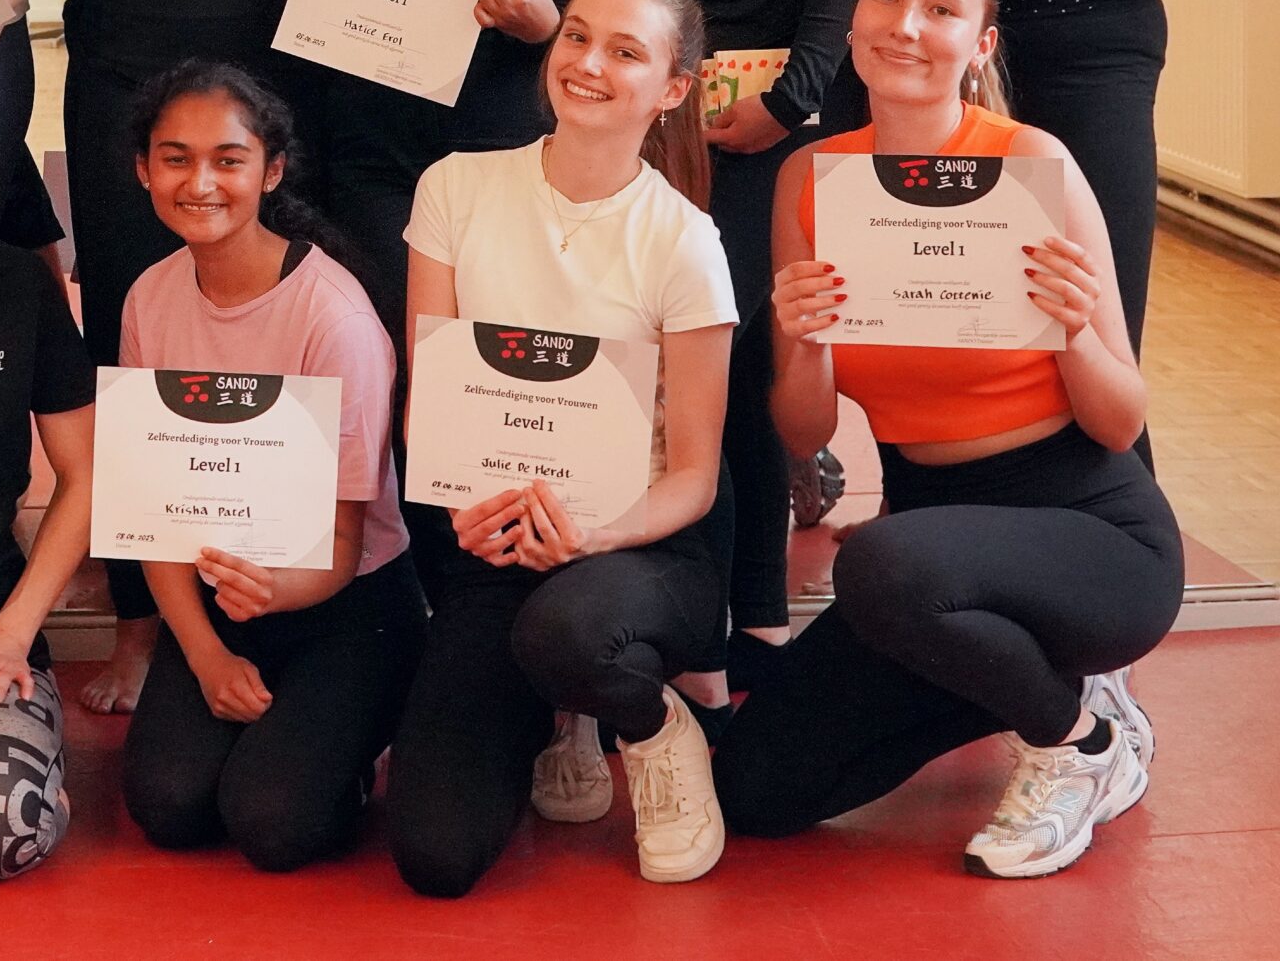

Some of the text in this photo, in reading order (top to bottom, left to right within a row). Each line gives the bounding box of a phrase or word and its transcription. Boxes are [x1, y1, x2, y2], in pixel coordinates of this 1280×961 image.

[934, 159, 977, 173] SANDO
[870, 218, 1008, 230] Zelfverdediging voor Vrouwen
[913, 241, 965, 256] Level 1
[893, 289, 933, 300] Sarah
[532, 334, 574, 350] SANDO
[216, 376, 258, 390] SANDO
[464, 384, 598, 410] Zelfverdediging voor Vrouwen
[503, 412, 554, 432] Level 1
[148, 432, 285, 447] Zelfverdediging voor Vrouwen
[189, 457, 241, 473] Level 1
[481, 458, 573, 479] Julie De Herdt
[165, 503, 251, 518] Krisha Patel
